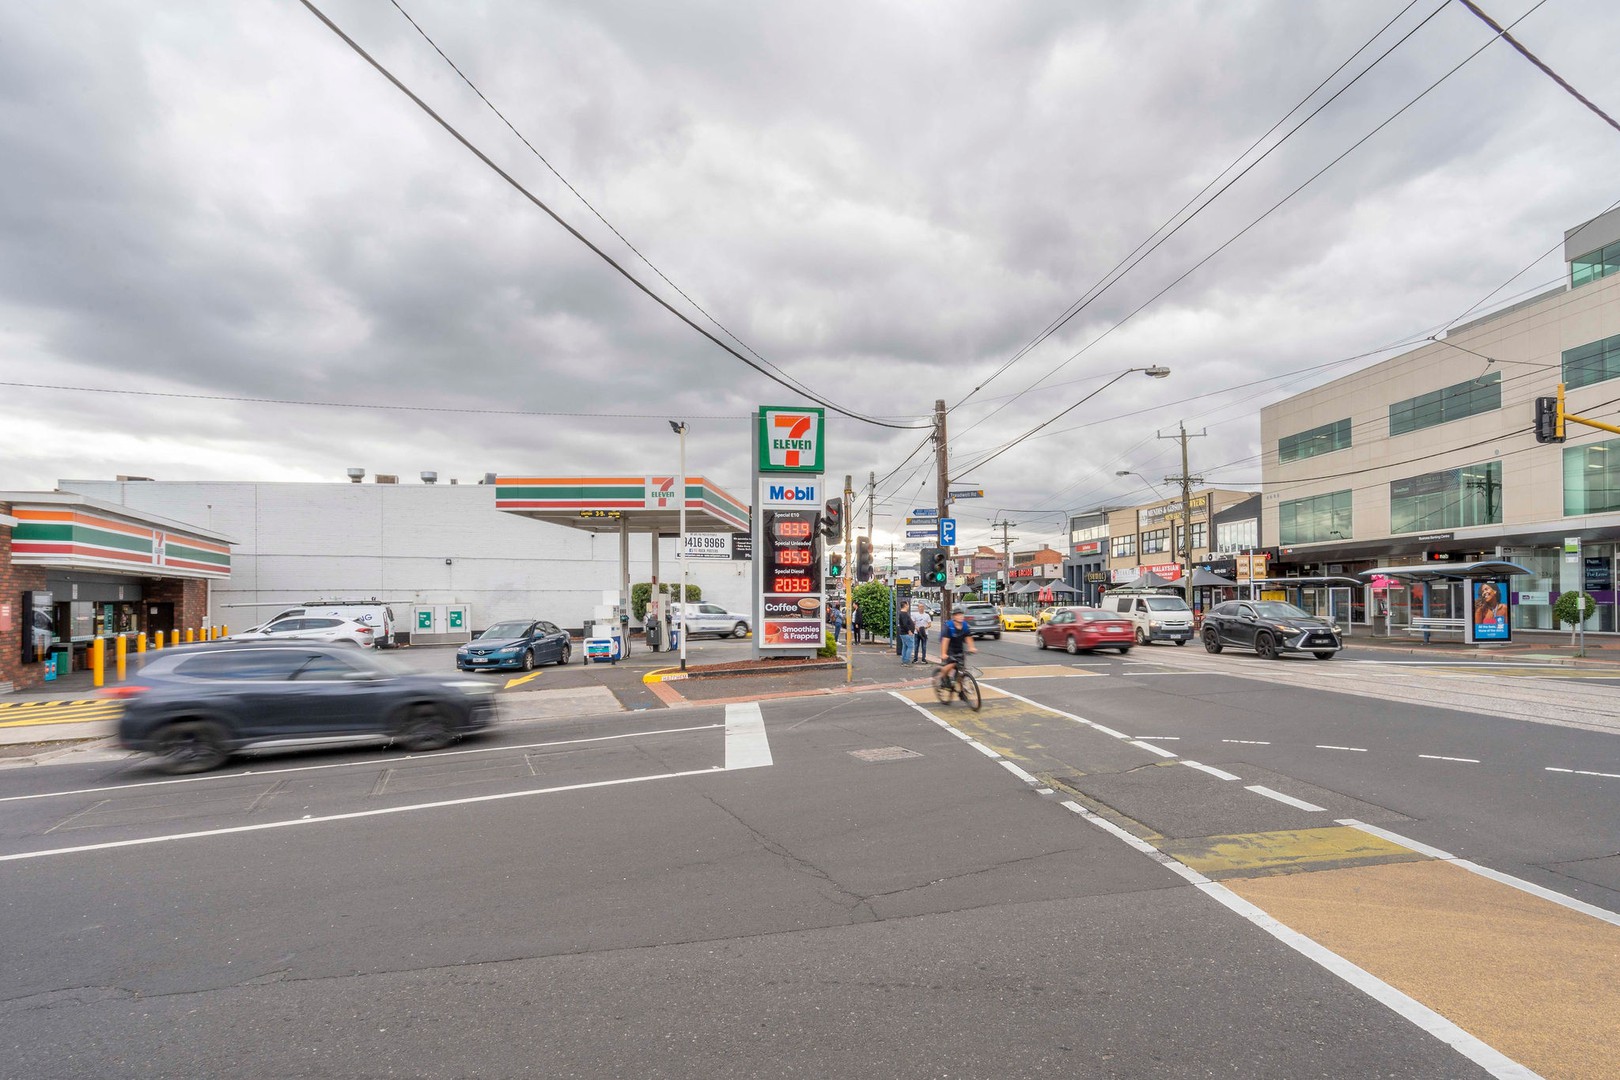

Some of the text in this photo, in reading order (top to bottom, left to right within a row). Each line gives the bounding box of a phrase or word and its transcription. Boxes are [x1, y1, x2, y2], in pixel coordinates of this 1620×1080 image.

[770, 486, 814, 500] Mobil
[780, 522, 810, 536] 193.9
[943, 522, 954, 535] P
[704, 537, 725, 548] 9966
[780, 550, 810, 564] 195.9
[775, 578, 810, 592] 203.9
[765, 603, 798, 611] Coffee
